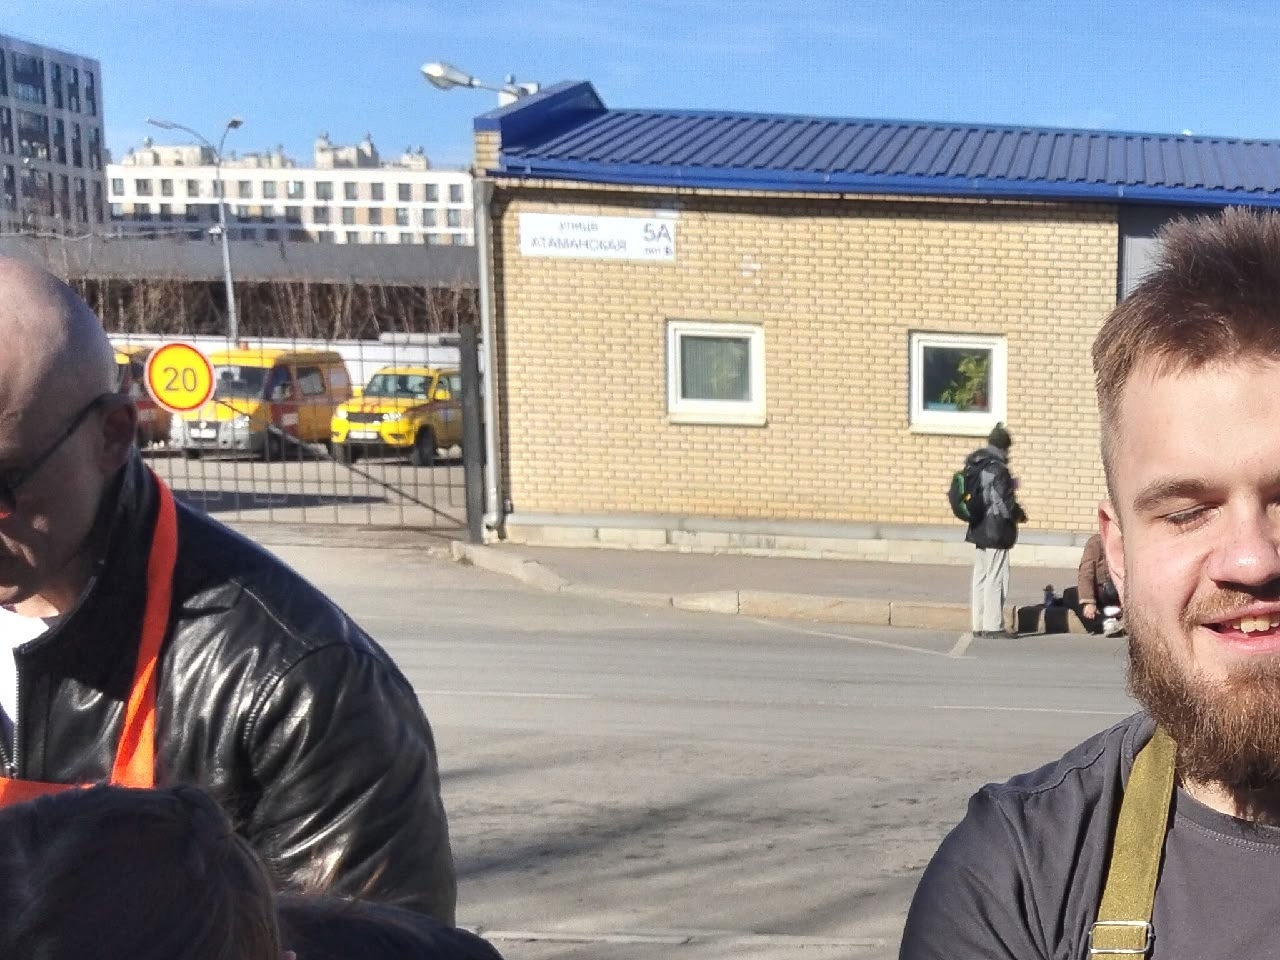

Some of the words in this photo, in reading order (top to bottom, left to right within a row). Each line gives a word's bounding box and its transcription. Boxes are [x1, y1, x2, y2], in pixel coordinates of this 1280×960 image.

[643, 222, 672, 243] 5А
[531, 236, 627, 252] АТАМАНСКАЯ
[163, 366, 197, 392] 20
